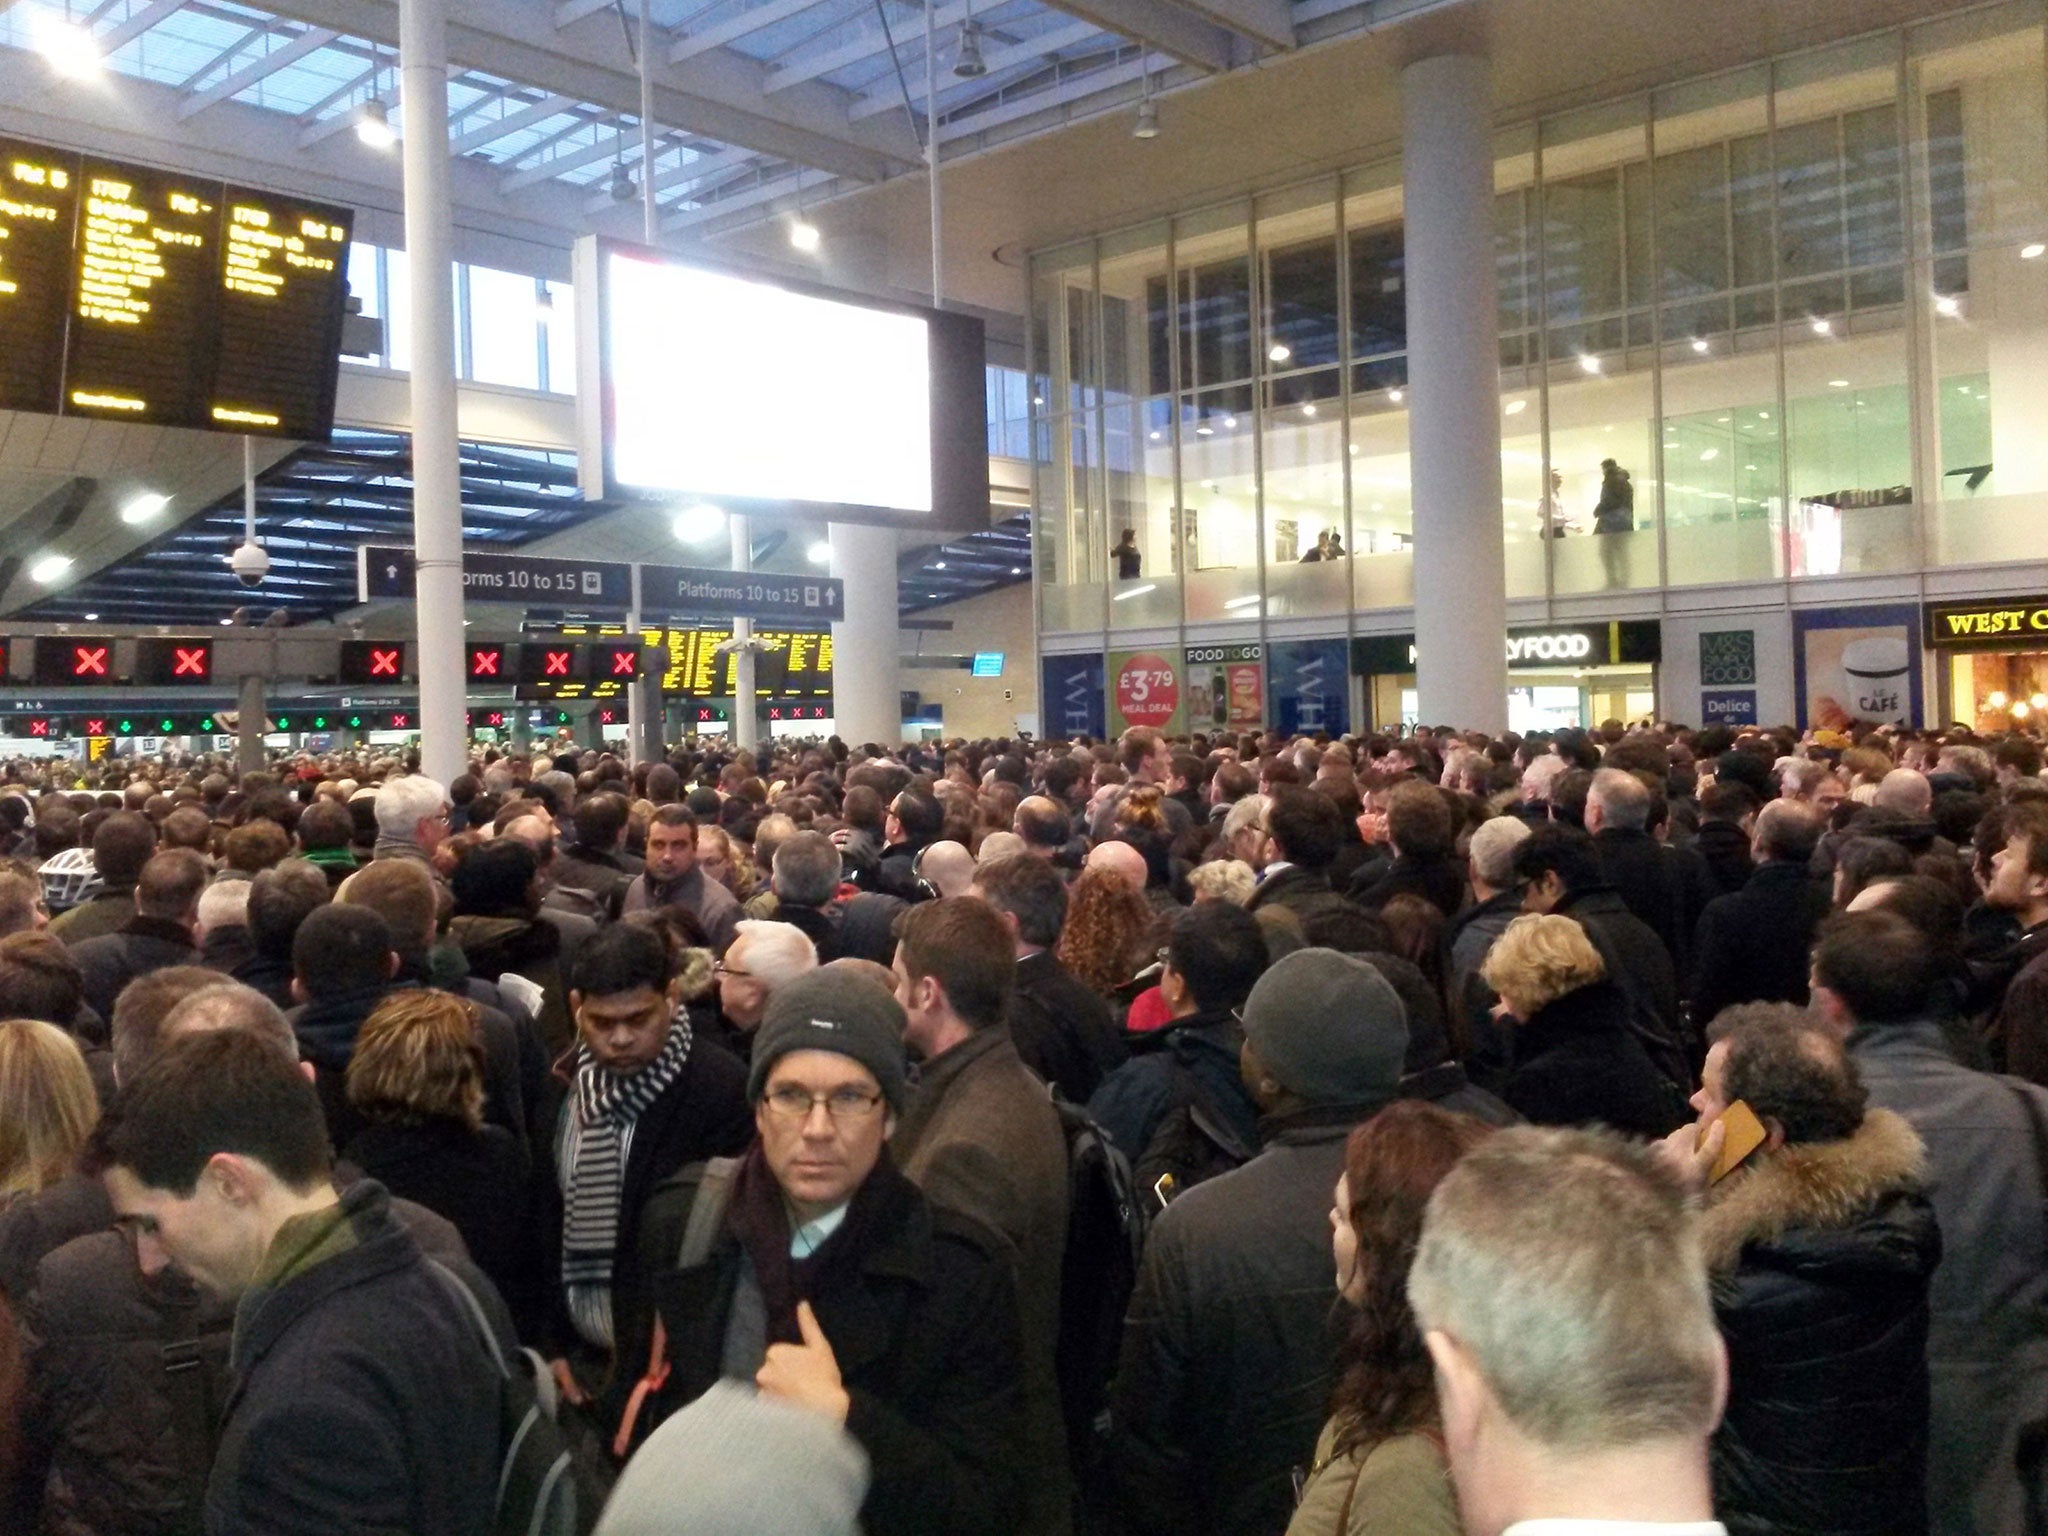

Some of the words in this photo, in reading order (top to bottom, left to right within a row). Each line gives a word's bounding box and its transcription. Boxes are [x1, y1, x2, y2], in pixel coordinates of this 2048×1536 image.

[463, 572, 504, 587] orms
[507, 571, 529, 588] 10
[533, 574, 551, 590] to
[556, 574, 576, 591] 15
[678, 580, 743, 600] Platforms
[747, 585, 763, 602] 10
[766, 588, 781, 602] to
[784, 588, 799, 603] 15
[1947, 610, 2025, 634] WEST
[1702, 634, 1752, 655] M&S
[1704, 665, 1753, 682] FOOD
[1122, 703, 1146, 714] MEAL
[1149, 703, 1174, 713] DEAL
[1708, 699, 1751, 713] Delice
[1859, 692, 1899, 713] CAFÉ
